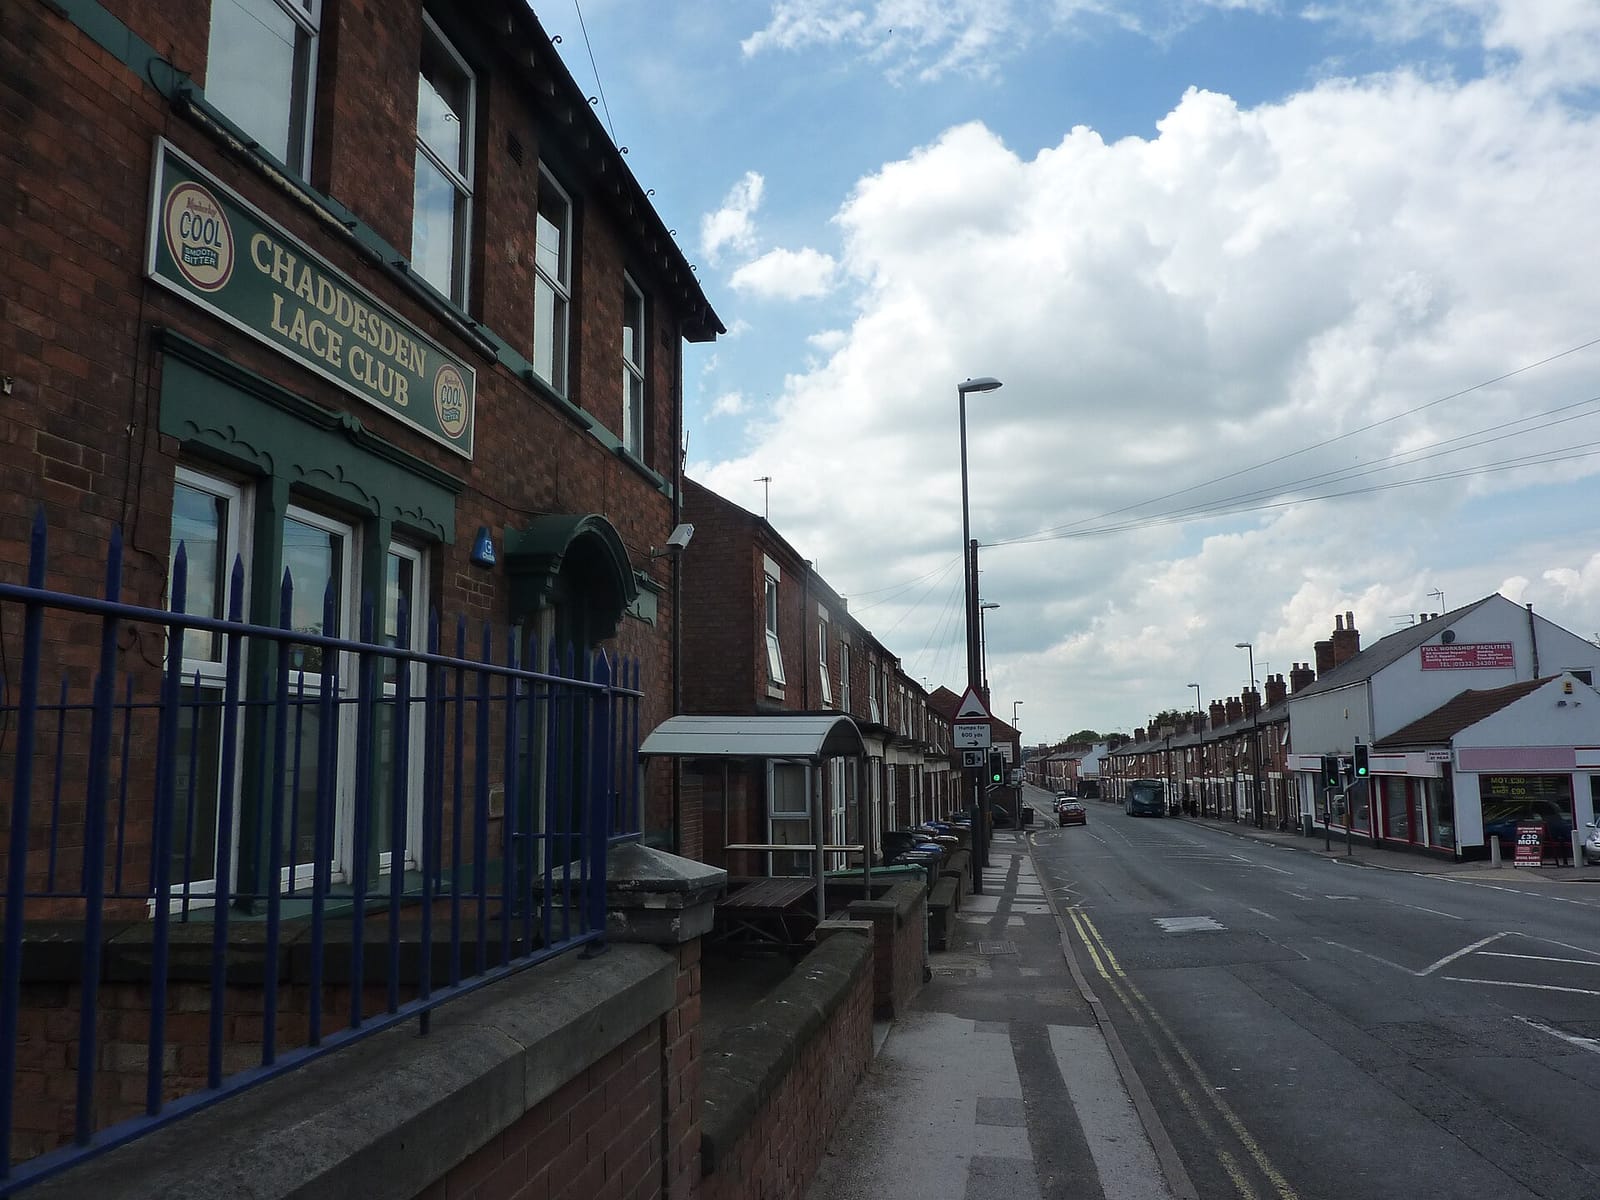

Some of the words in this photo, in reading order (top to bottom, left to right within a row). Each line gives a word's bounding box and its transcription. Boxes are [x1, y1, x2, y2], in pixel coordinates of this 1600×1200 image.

[180, 211, 222, 248] COOL
[184, 247, 217, 260] SMOOTH
[184, 253, 216, 266] BITTER
[250, 232, 427, 378] CHADDESDEN
[271, 292, 343, 369] LACE
[348, 345, 409, 407] CLUB
[441, 384, 462, 407] COOL
